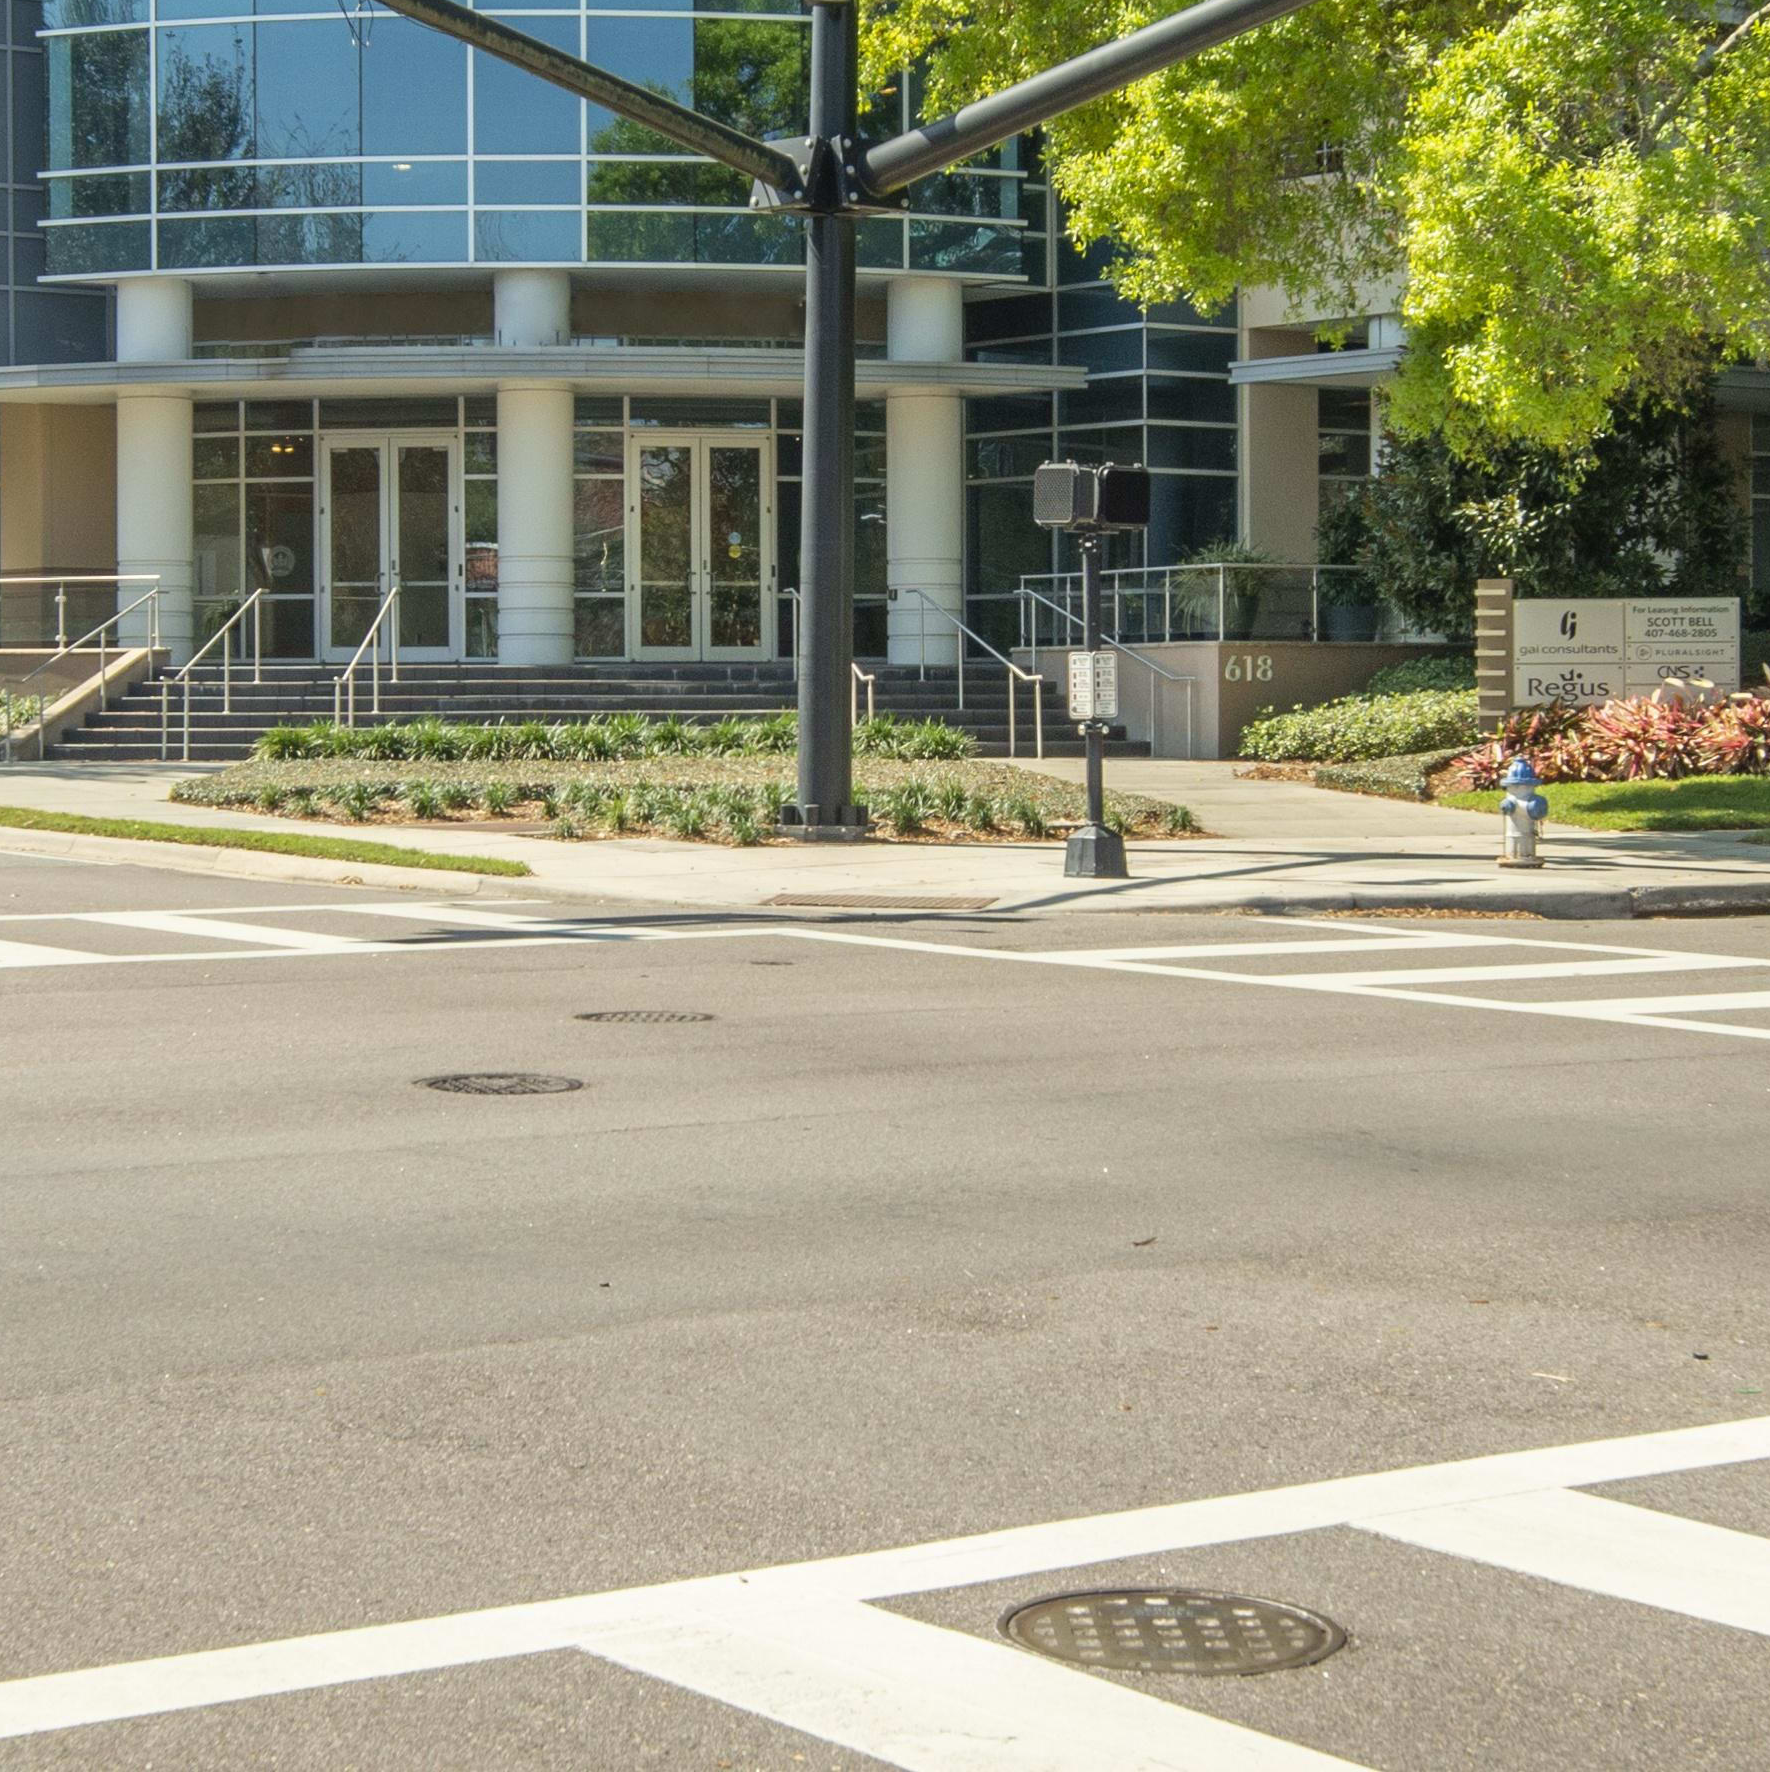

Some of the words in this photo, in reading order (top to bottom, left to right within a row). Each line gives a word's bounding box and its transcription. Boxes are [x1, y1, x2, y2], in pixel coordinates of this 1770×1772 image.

[1632, 606, 1646, 614] For
[1647, 606, 1679, 615] Leasing
[1680, 605, 1730, 614] Information
[1647, 616, 1686, 627] SCOTT
[1688, 616, 1714, 627] BELL
[1644, 628, 1718, 638] 407-468-2805
[1519, 643, 1539, 656] gai
[1542, 643, 1618, 654] consultants
[1225, 655, 1273, 681] 618
[1657, 665, 1691, 679] CNS
[1528, 678, 1610, 703] Regus
